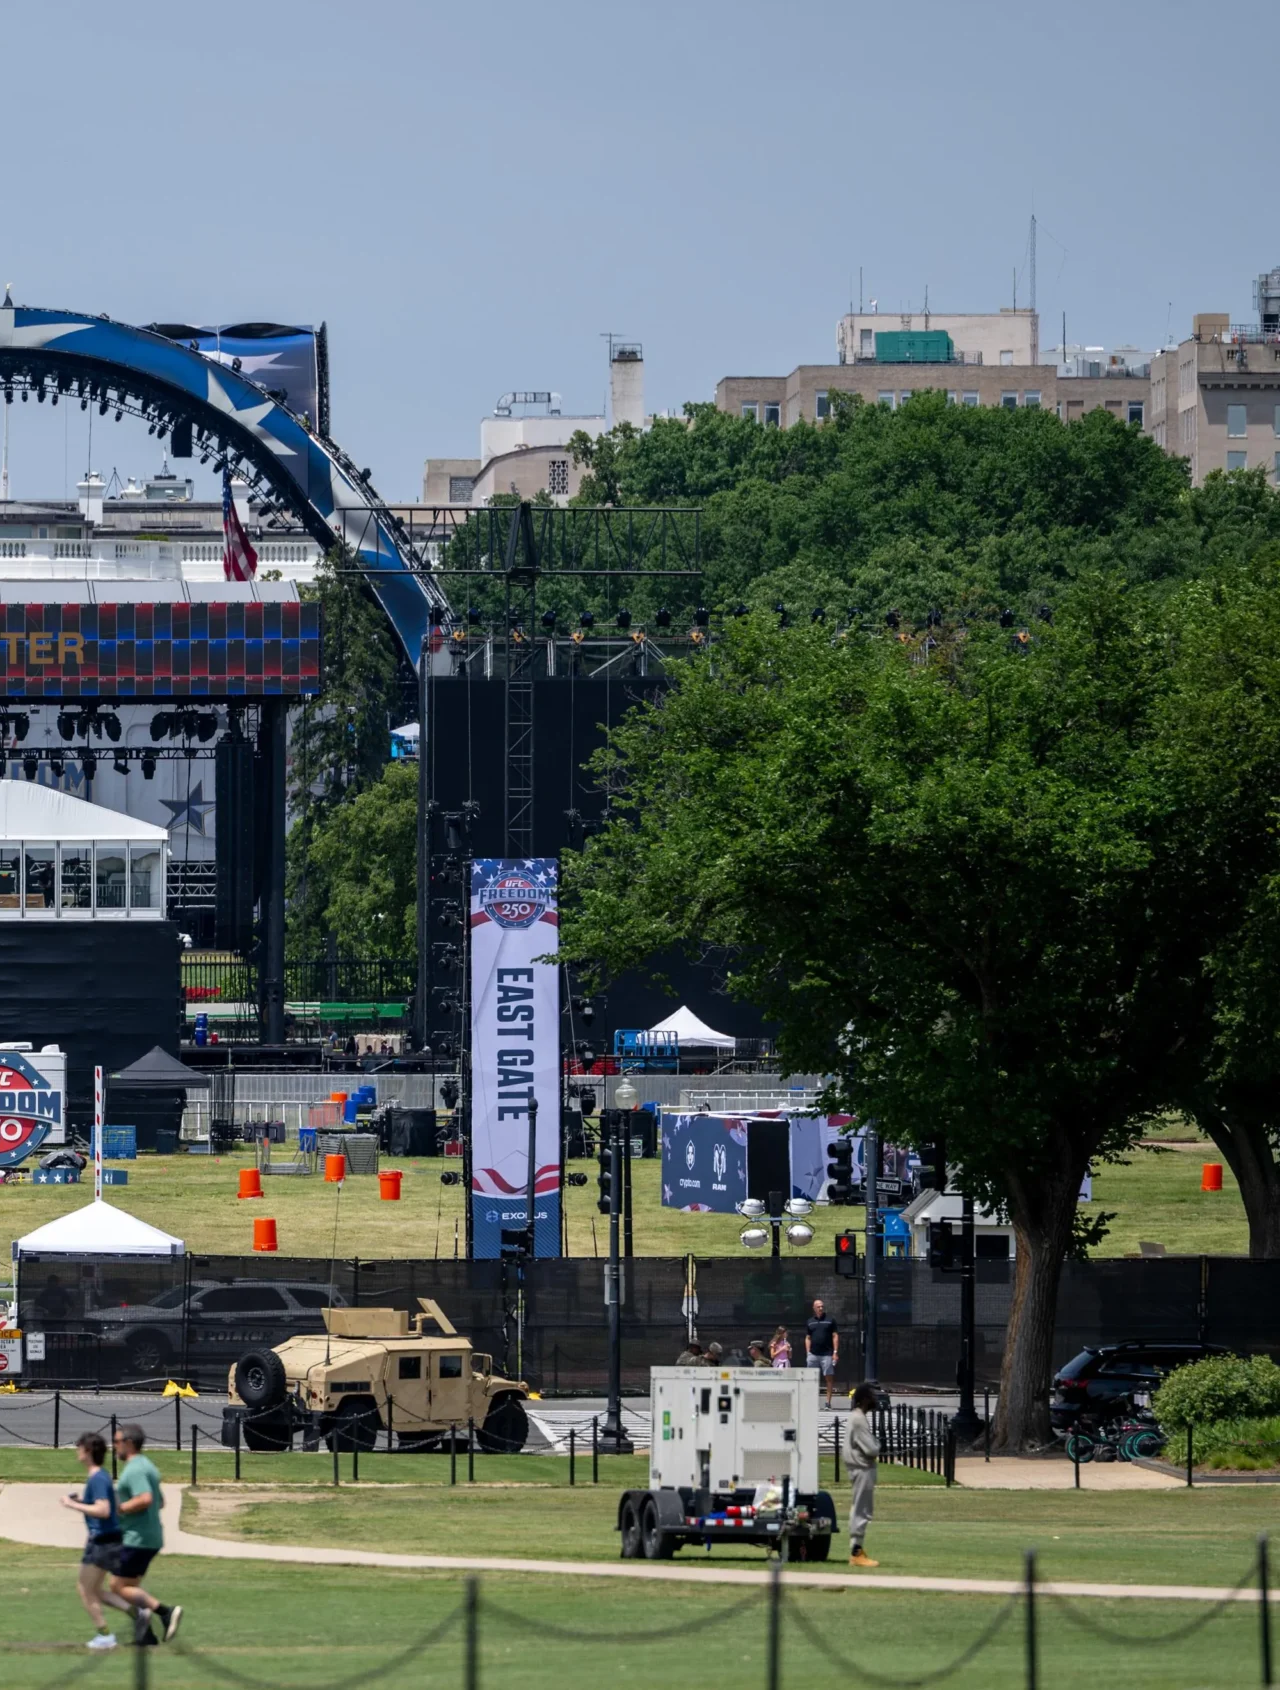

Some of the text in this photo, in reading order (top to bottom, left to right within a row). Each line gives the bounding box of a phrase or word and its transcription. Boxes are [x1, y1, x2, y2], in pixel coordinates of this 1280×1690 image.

[505, 880, 525, 888] UFC
[479, 888, 550, 905] FREEDOM
[501, 903, 530, 919] 250
[497, 967, 534, 1122] EAST GATE
[679, 1178, 701, 1188] crypto.com
[712, 1183, 727, 1191] RAM
[502, 1211, 548, 1220] EXOUS
